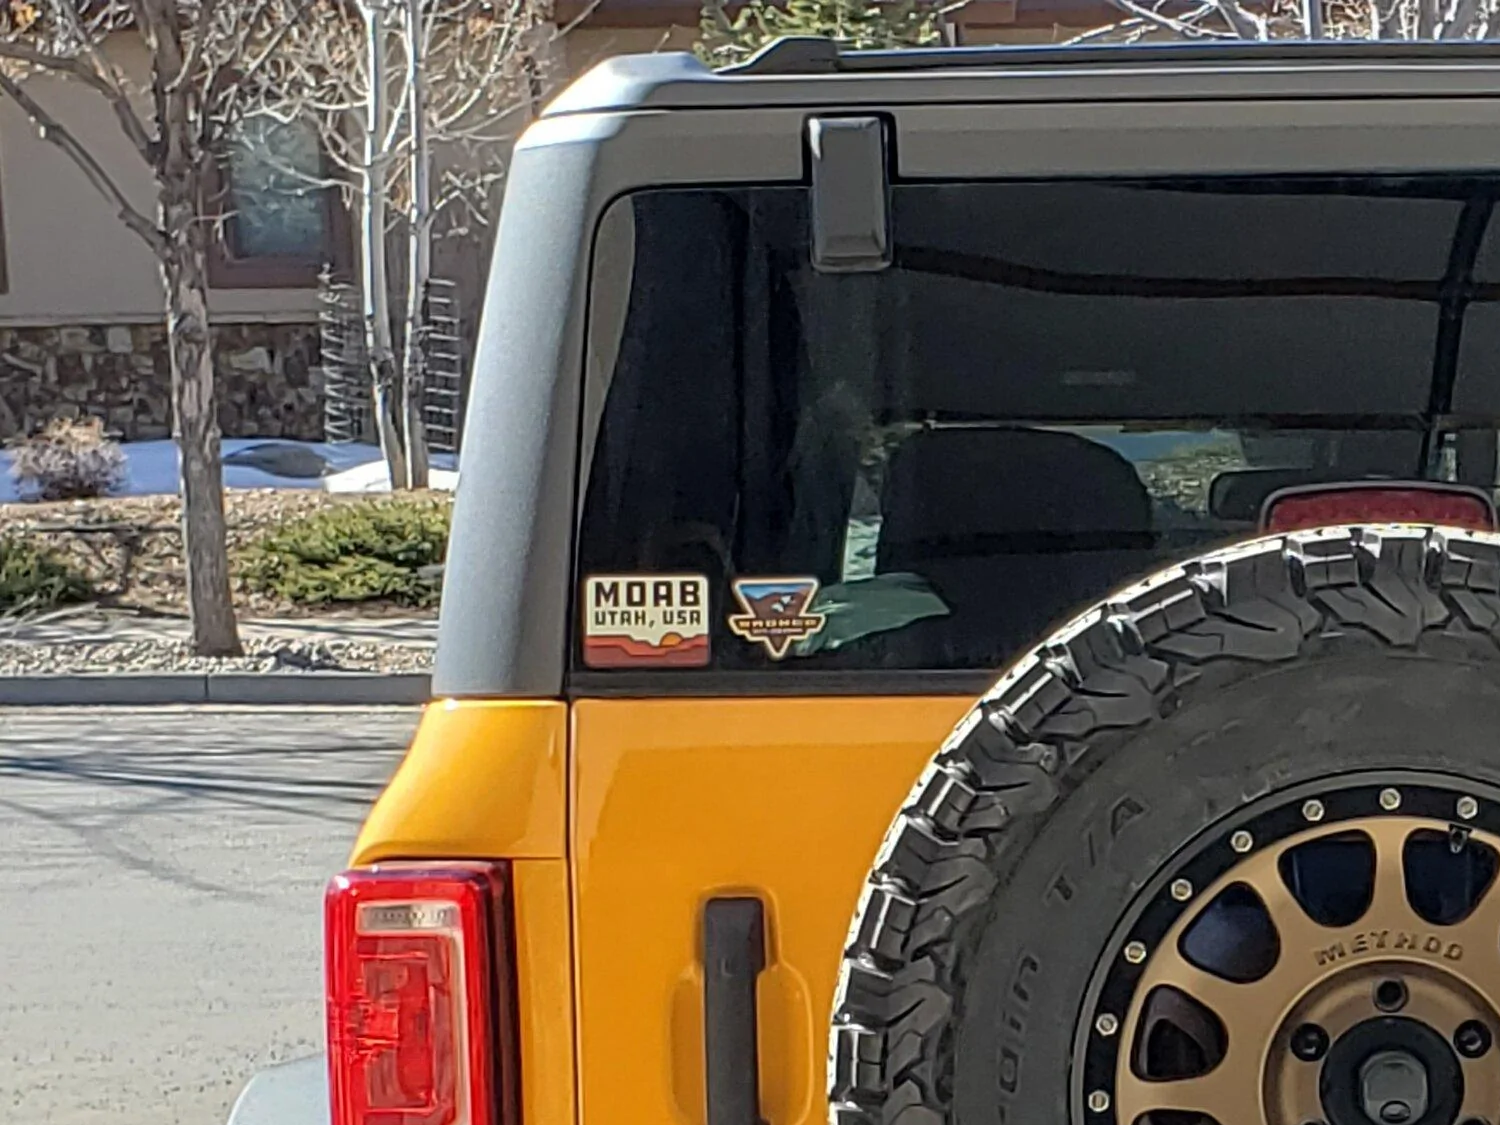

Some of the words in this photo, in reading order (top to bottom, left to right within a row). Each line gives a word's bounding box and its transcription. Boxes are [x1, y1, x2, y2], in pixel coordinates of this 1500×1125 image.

[594, 581, 701, 607] MOAB
[594, 610, 656, 628] UTAH,
[662, 609, 701, 626] USA
[1313, 929, 1464, 966] METHOD
